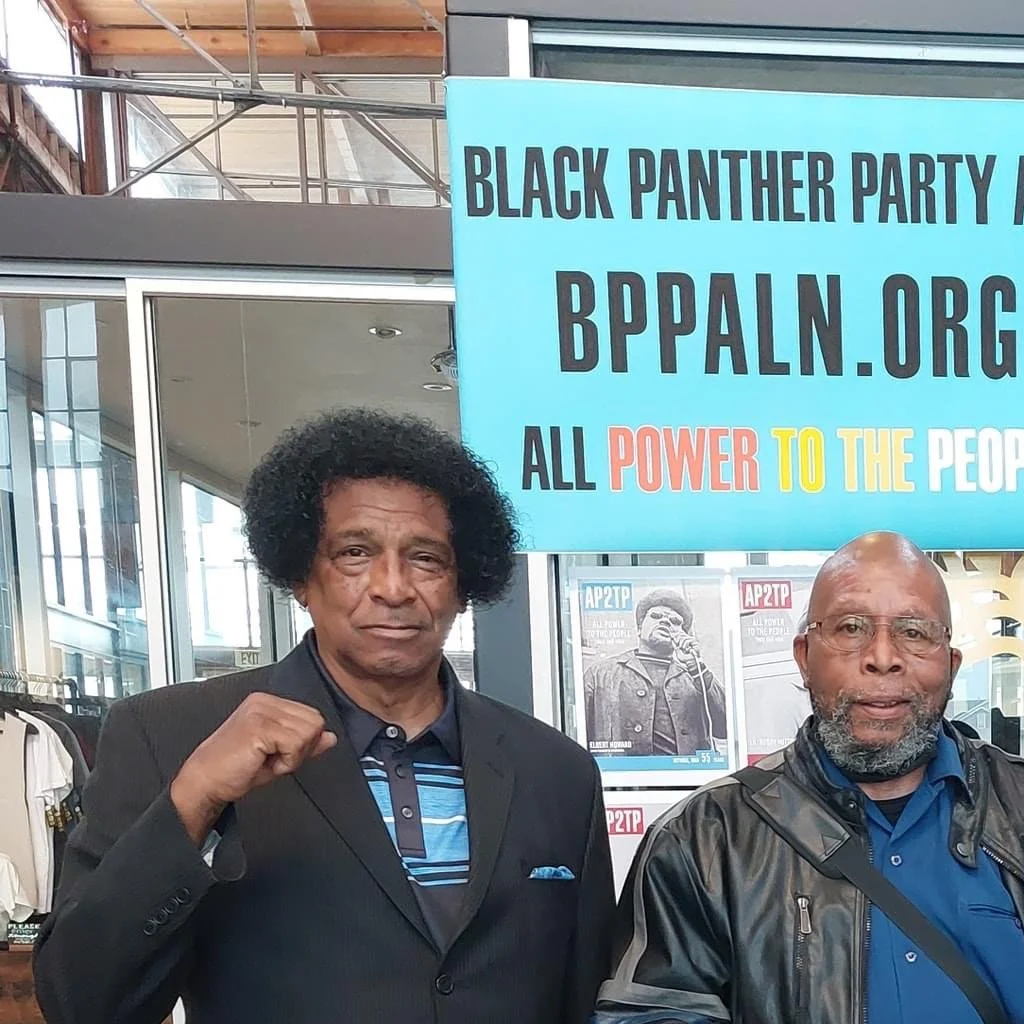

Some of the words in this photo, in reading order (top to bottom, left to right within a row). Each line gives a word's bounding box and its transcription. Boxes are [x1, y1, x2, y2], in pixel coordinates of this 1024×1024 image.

[463, 145, 614, 220] BLACK
[628, 147, 837, 223] PANTHER
[851, 152, 997, 225] PARTY
[555, 270, 1017, 380] BPPALN.ORG
[521, 425, 596, 491] ALL
[608, 425, 760, 493] POWER
[771, 427, 825, 493] TO
[837, 427, 915, 492] THE
[585, 585, 631, 609] AP2TP
[745, 583, 790, 607] AP2TP
[607, 810, 642, 833] P2TP
